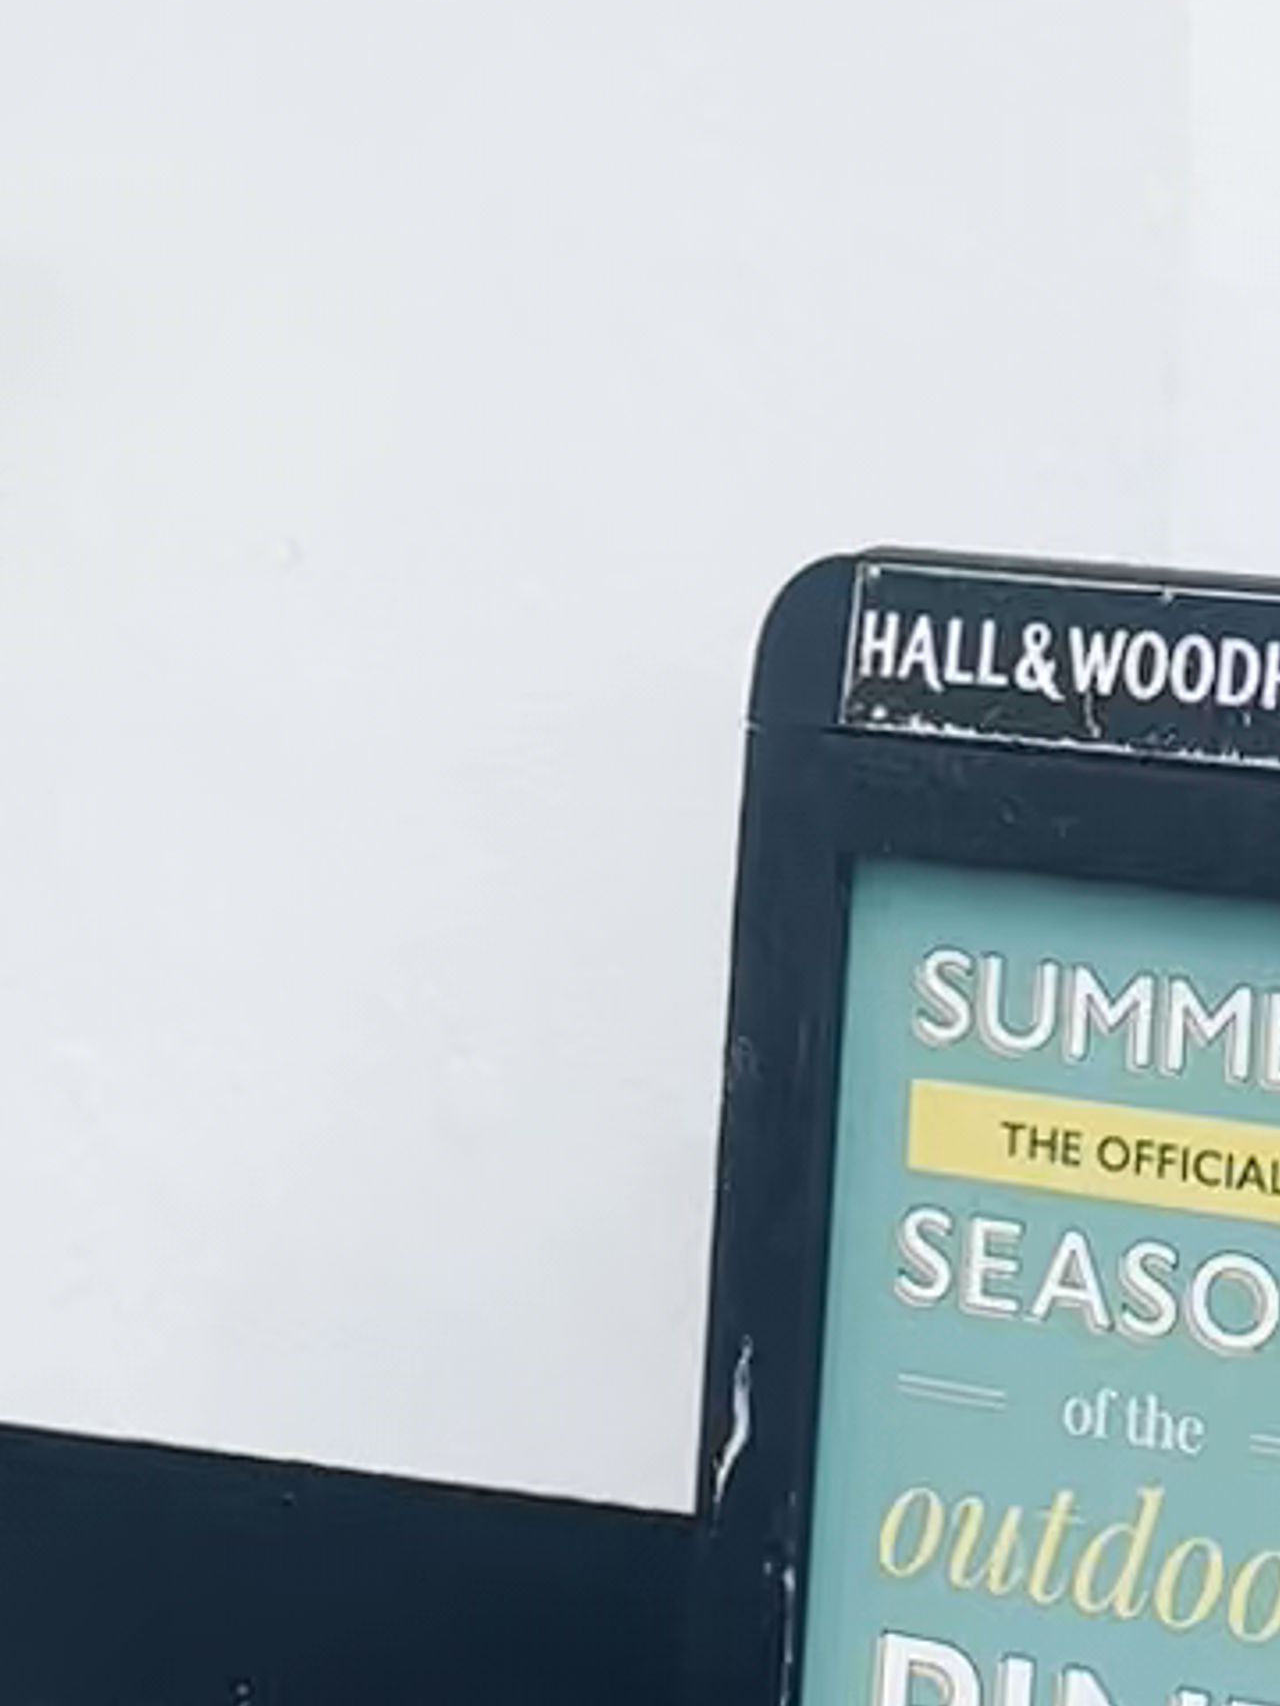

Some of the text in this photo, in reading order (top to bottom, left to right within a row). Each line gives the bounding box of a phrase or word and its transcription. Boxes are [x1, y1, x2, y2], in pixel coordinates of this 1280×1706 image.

[1001, 1121, 1083, 1167] THE
[1063, 1387, 1205, 1455] of the
